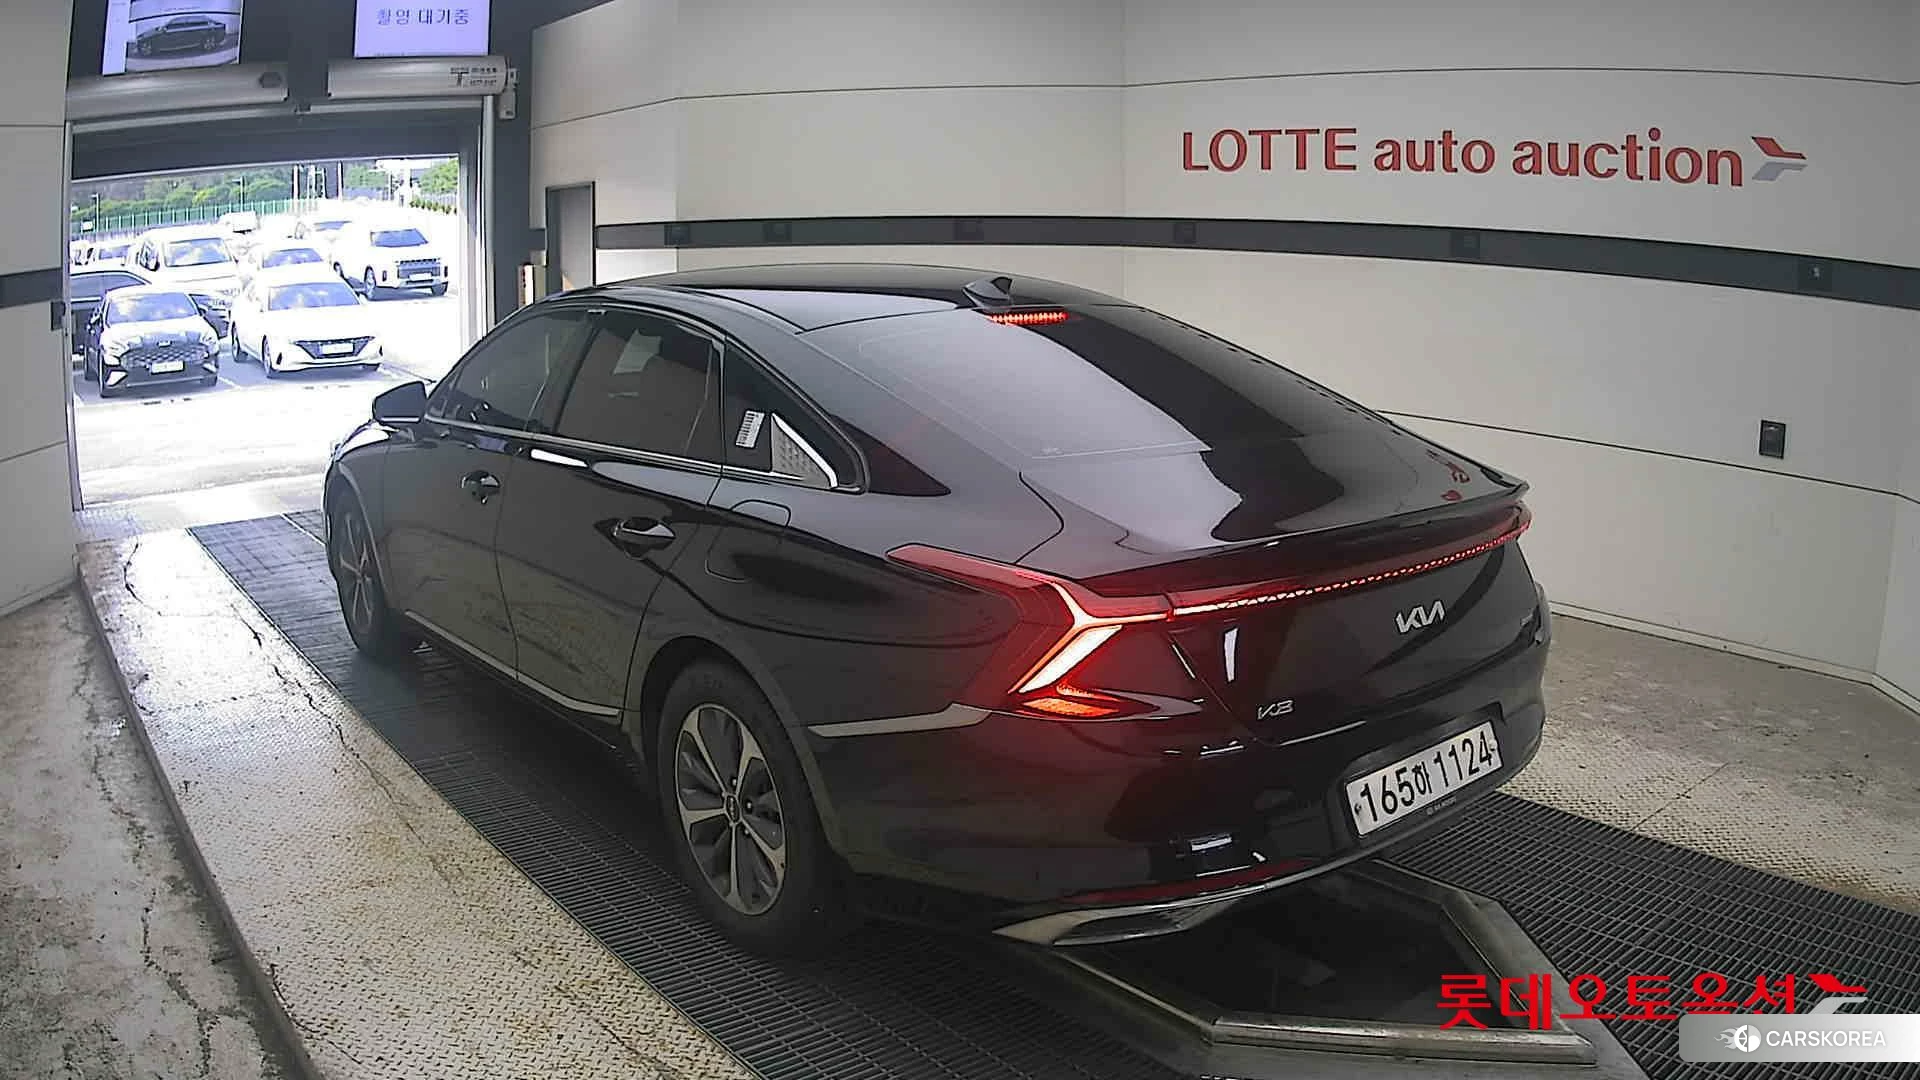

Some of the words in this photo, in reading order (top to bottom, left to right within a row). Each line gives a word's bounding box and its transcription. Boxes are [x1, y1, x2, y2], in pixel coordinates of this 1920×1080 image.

[1183, 128, 1357, 172] LOTTE
[1374, 130, 1496, 174] auto
[1512, 127, 1743, 187] auction
[1256, 700, 1294, 720] K8
